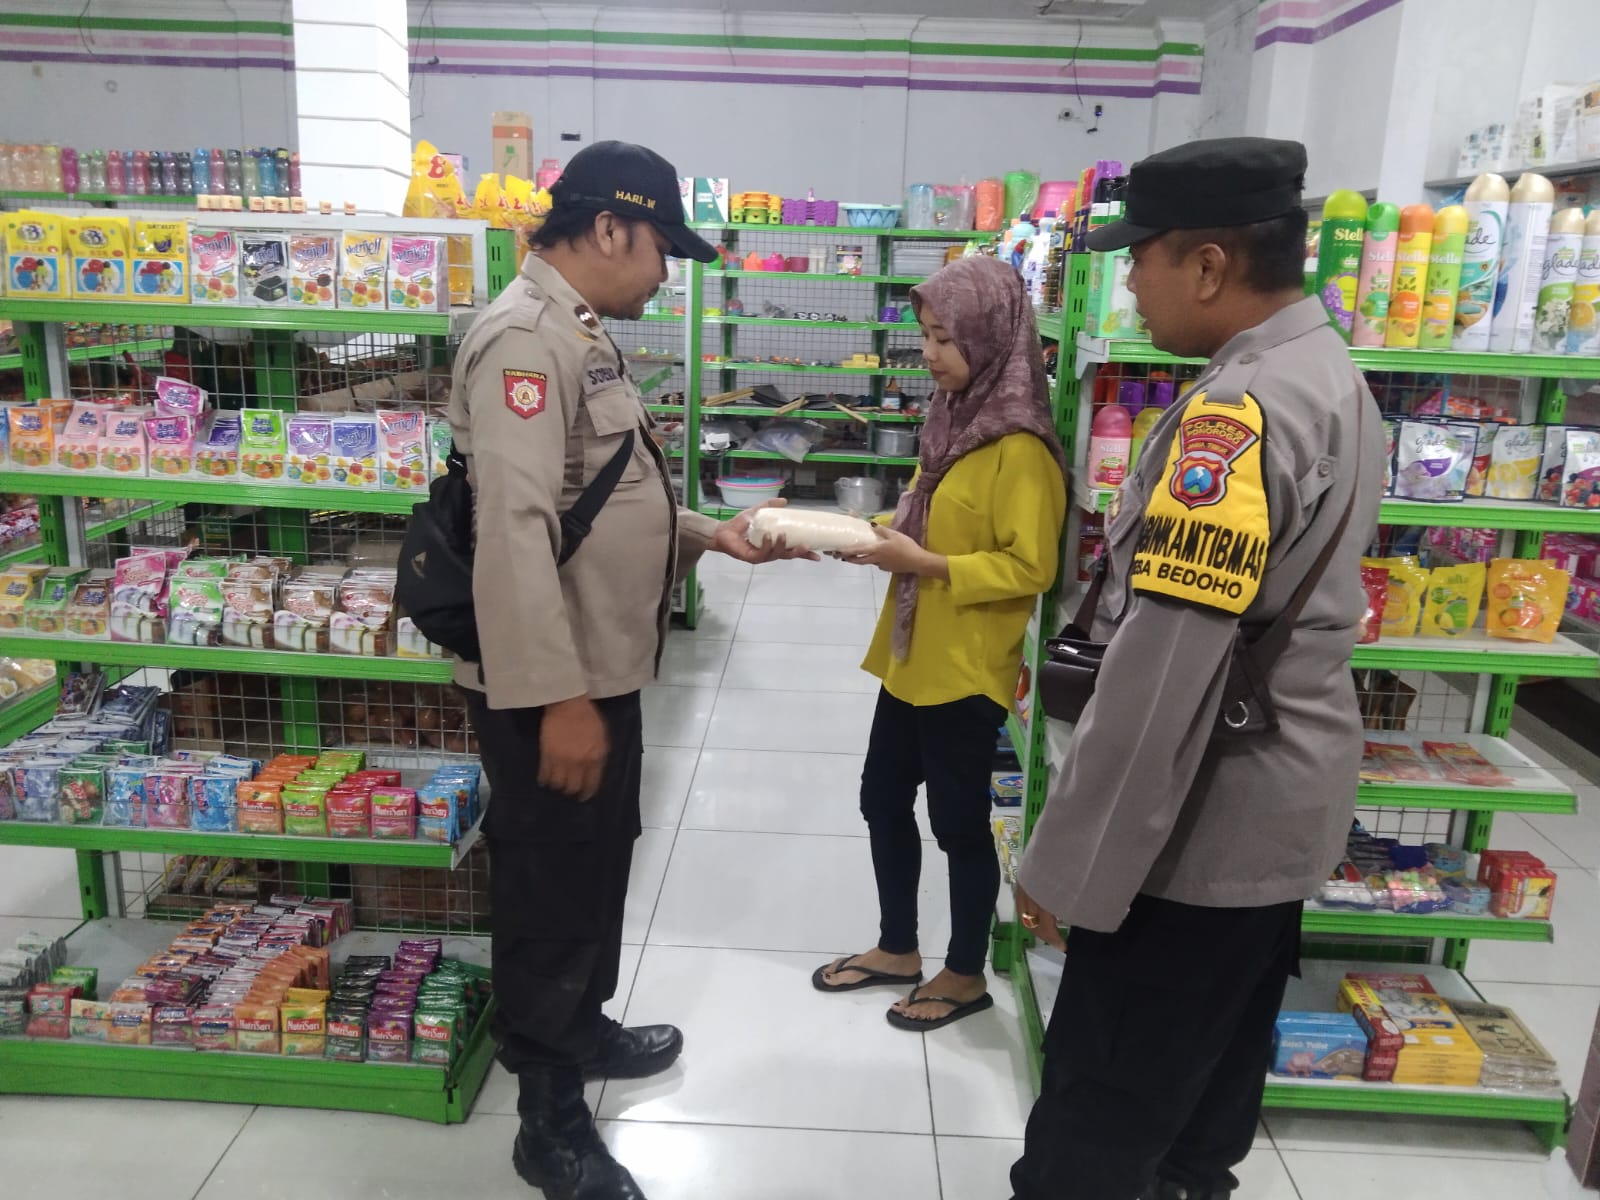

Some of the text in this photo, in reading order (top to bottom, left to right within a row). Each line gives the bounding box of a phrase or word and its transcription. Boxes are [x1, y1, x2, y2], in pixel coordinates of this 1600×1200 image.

[1333, 227, 1364, 241] Stell
[1367, 250, 1394, 262] Stell
[1157, 563, 1243, 600] BEDOHO
